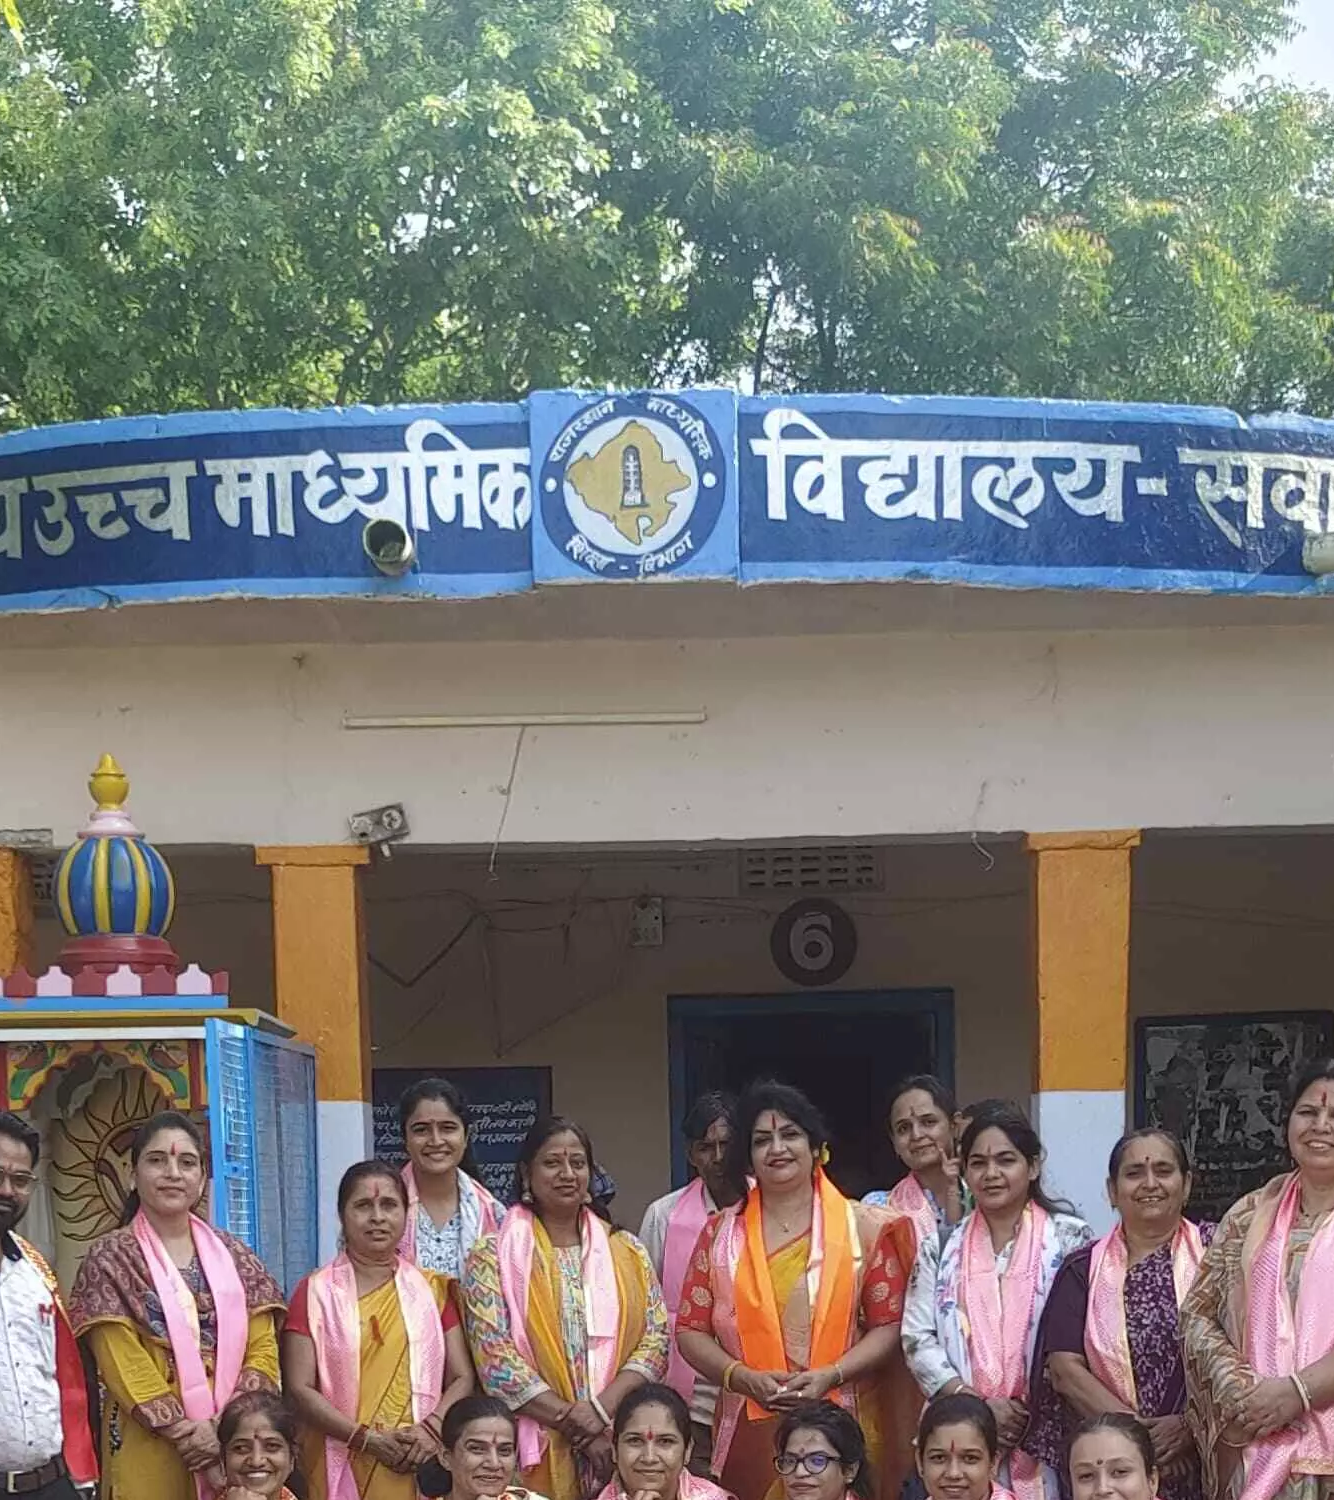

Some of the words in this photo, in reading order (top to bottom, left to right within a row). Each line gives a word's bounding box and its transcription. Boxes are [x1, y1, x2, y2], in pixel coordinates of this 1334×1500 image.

[31, 460, 197, 556] उच्च
[204, 418, 532, 537] माध्यमिक
[750, 408, 1142, 529] विद्यालय
[789, 911, 835, 971] 6
